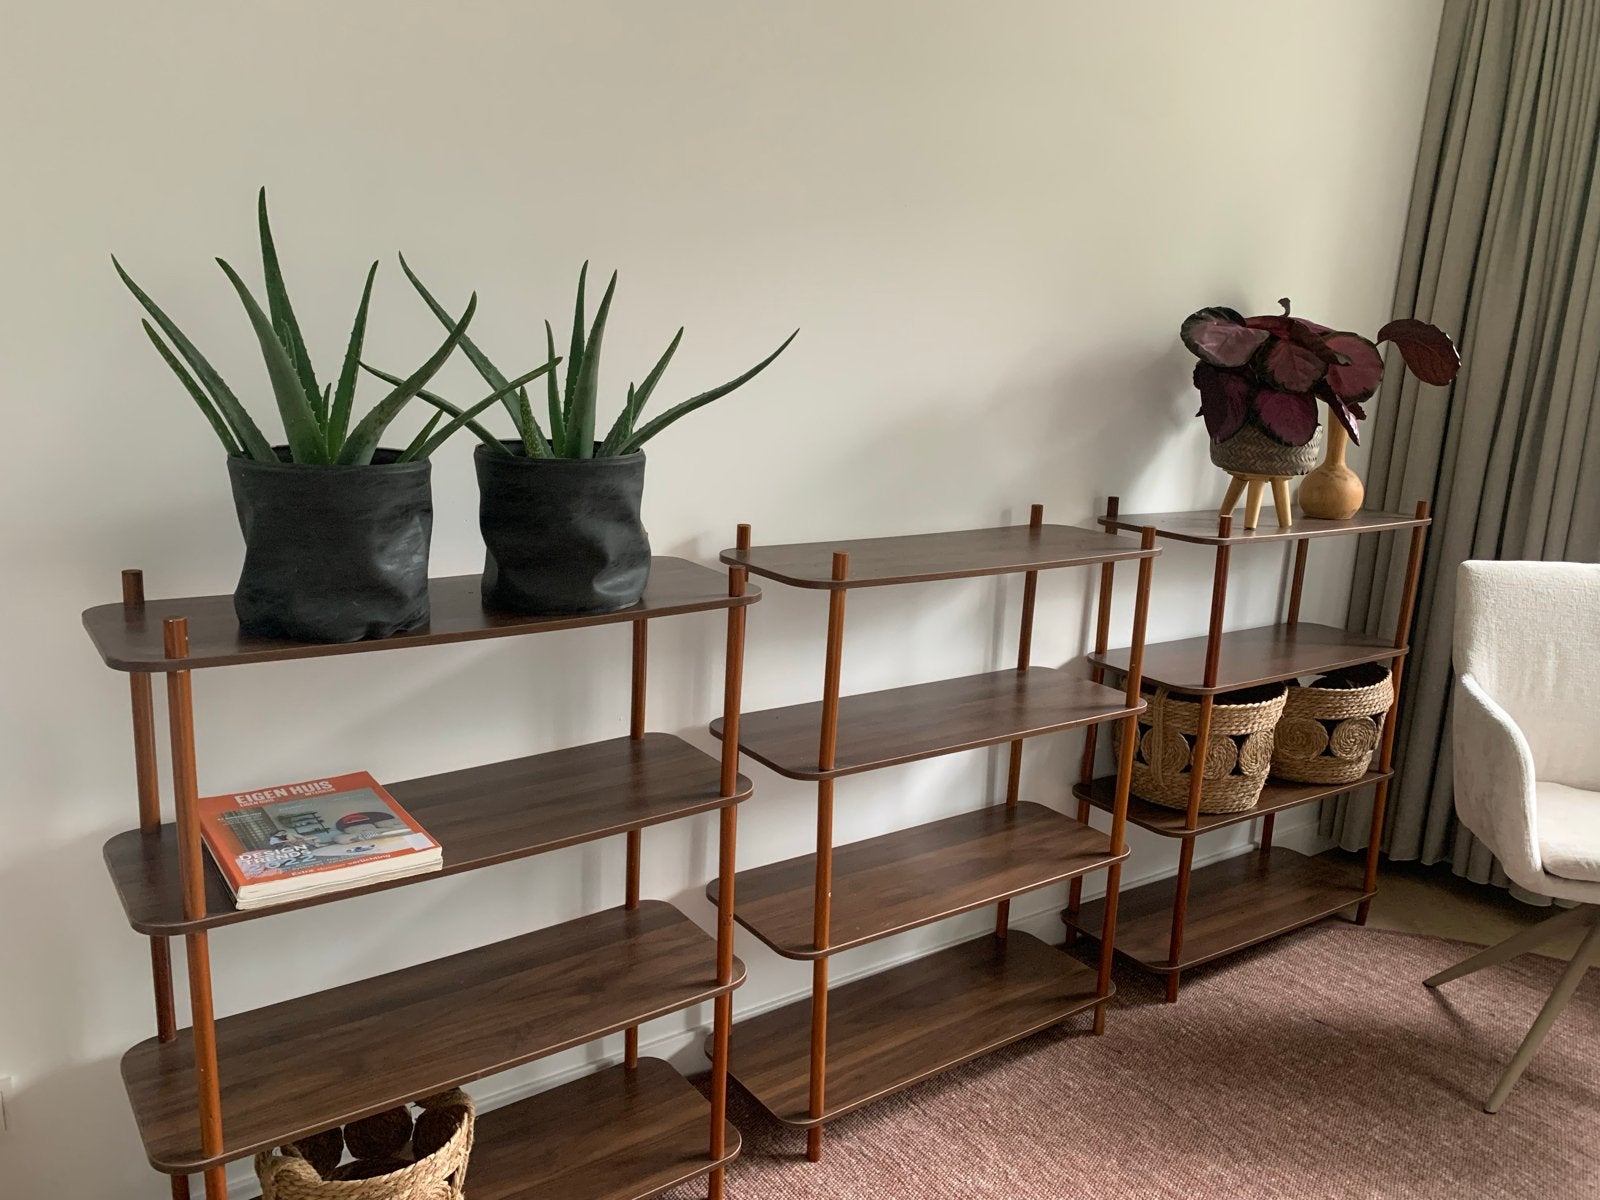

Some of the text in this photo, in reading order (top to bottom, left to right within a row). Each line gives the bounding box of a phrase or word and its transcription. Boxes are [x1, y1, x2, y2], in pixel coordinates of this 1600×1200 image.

[234, 781, 333, 804] EIGEN HUIS
[239, 844, 308, 861] DESIGN
[247, 850, 312, 865] TRENDS
[248, 854, 317, 872] 2022
